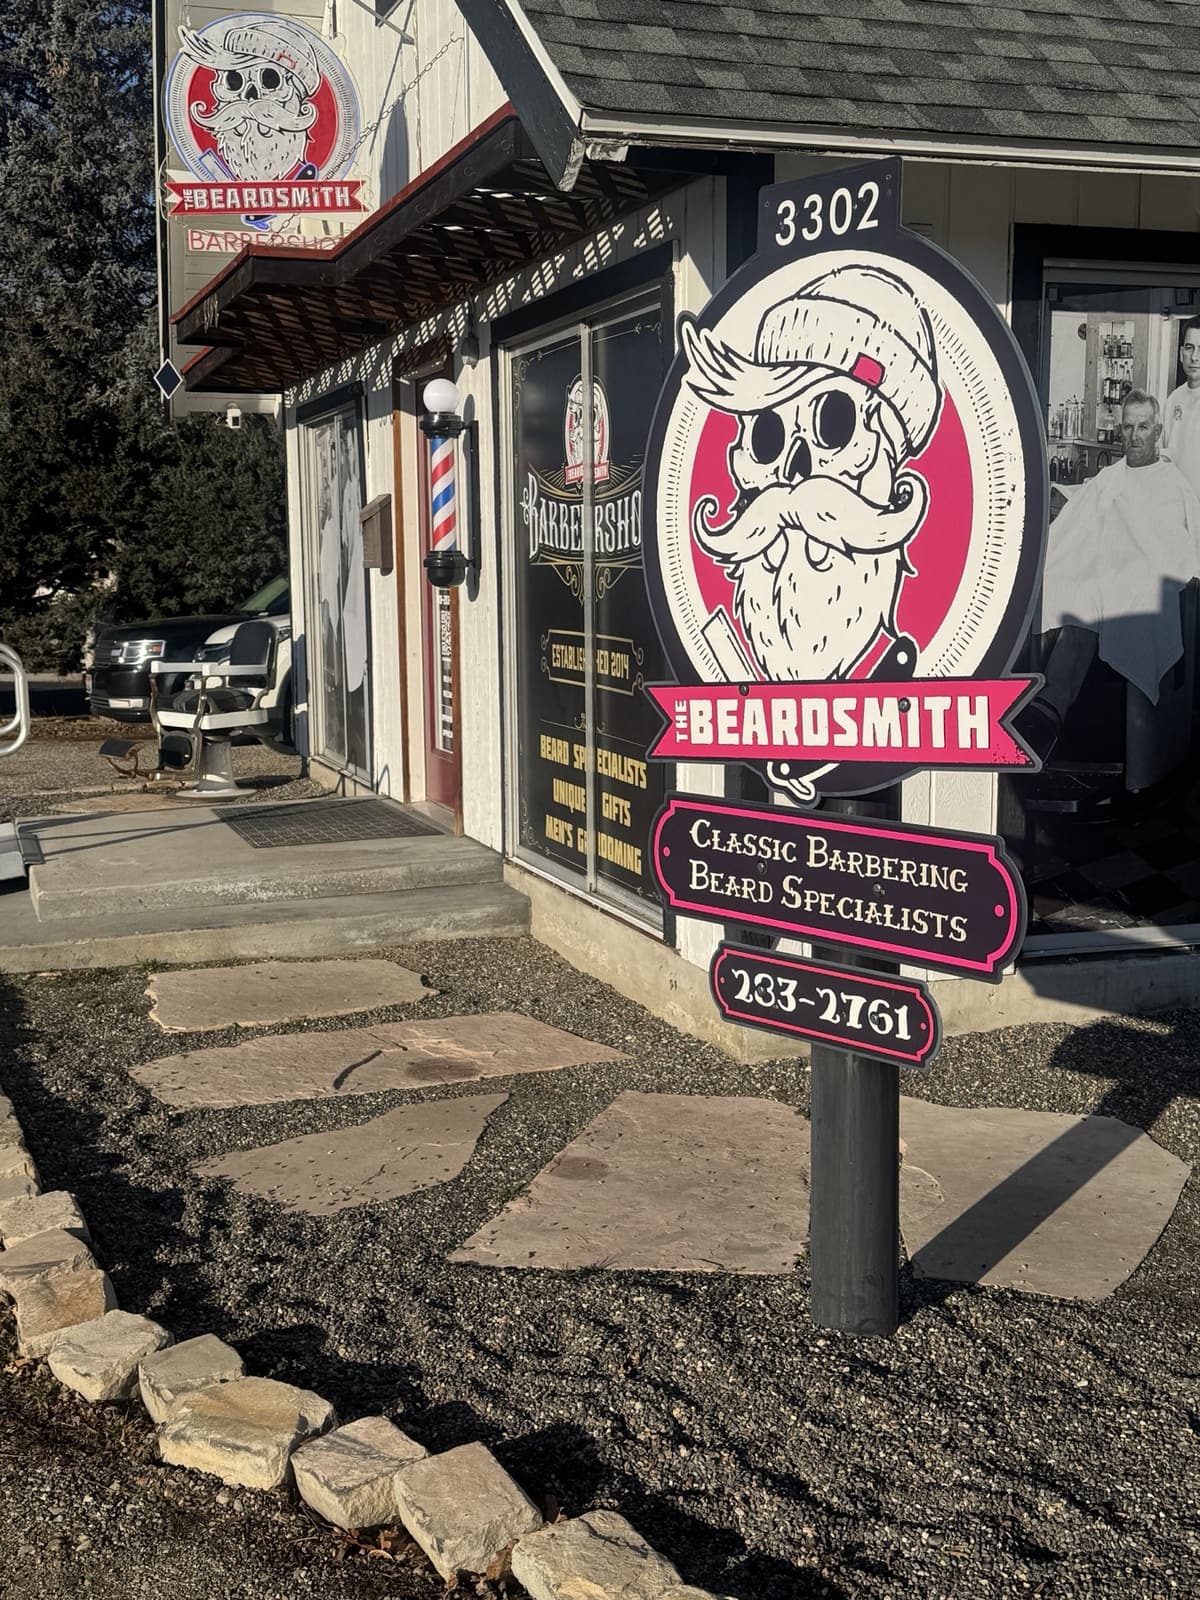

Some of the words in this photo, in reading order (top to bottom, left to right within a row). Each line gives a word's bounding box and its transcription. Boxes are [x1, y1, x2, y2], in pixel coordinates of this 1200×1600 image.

[183, 188, 193, 210] THE
[193, 187, 350, 209] BEARDSMITH
[775, 181, 880, 246] 3302
[188, 229, 346, 252] BARBERSHO
[551, 643, 609, 675] ESTABLISHED
[610, 651, 630, 680] 2014
[674, 699, 689, 743] THE
[689, 695, 990, 749] BEARDSMITH
[540, 734, 570, 766] BEARD
[573, 743, 647, 789] SPECIALISTS
[552, 778, 587, 813] UNIQUE
[602, 791, 632, 827] GIFTS
[545, 814, 574, 849] MEN'S
[689, 818, 797, 865] CLASSIC
[806, 835, 969, 893] BARBERING
[688, 859, 774, 903] BEARD
[781, 875, 968, 943] SPECIALISTS
[731, 968, 912, 1041] 283-2761
